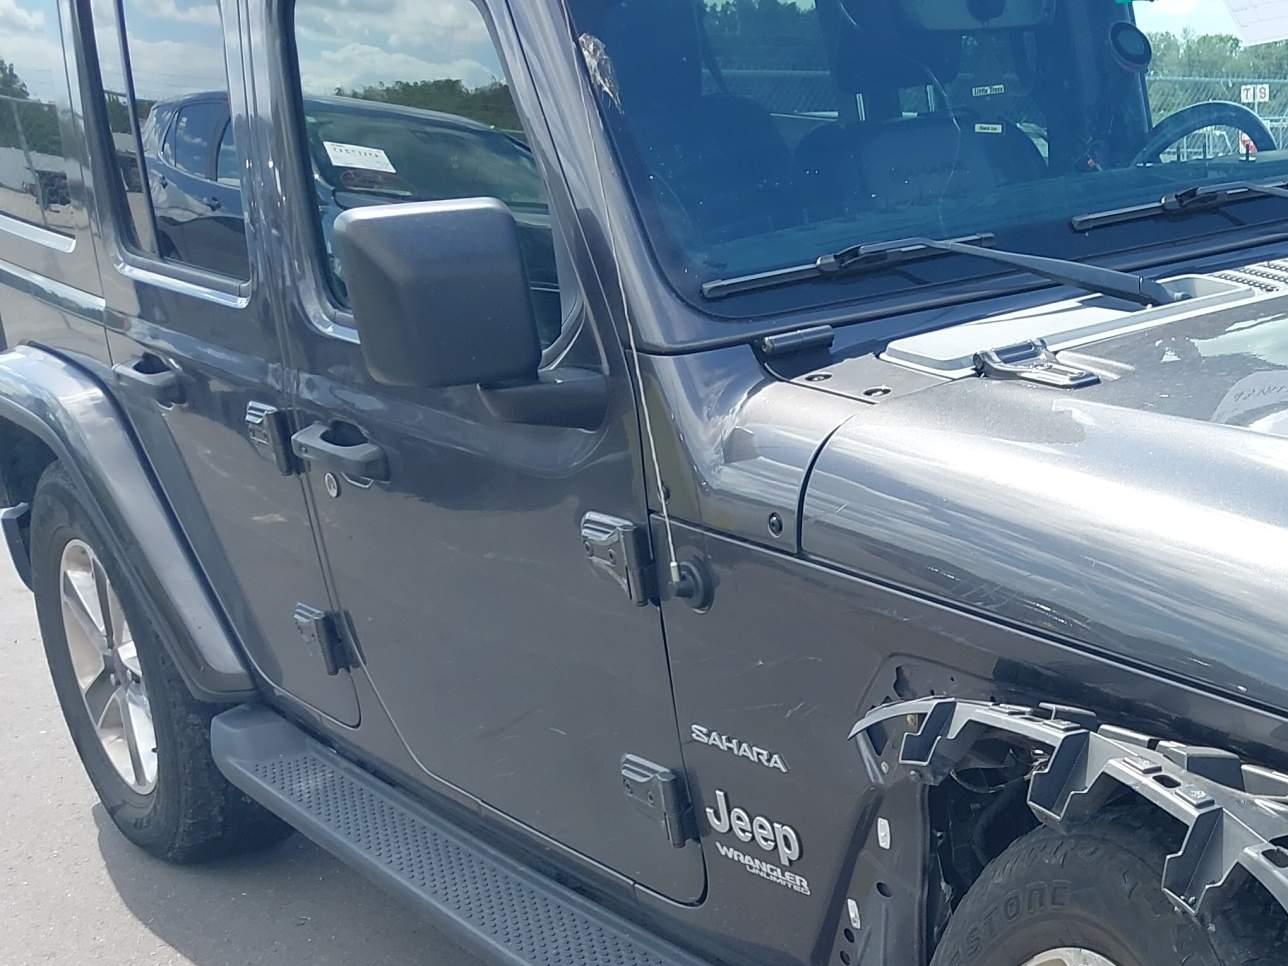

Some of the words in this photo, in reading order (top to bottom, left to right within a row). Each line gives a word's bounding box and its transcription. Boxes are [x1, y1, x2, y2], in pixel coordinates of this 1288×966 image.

[691, 724, 789, 773] SAHARA
[705, 790, 801, 867] Jeep
[715, 841, 809, 887] WRANGLER
[746, 864, 811, 896] UNLIMITED
